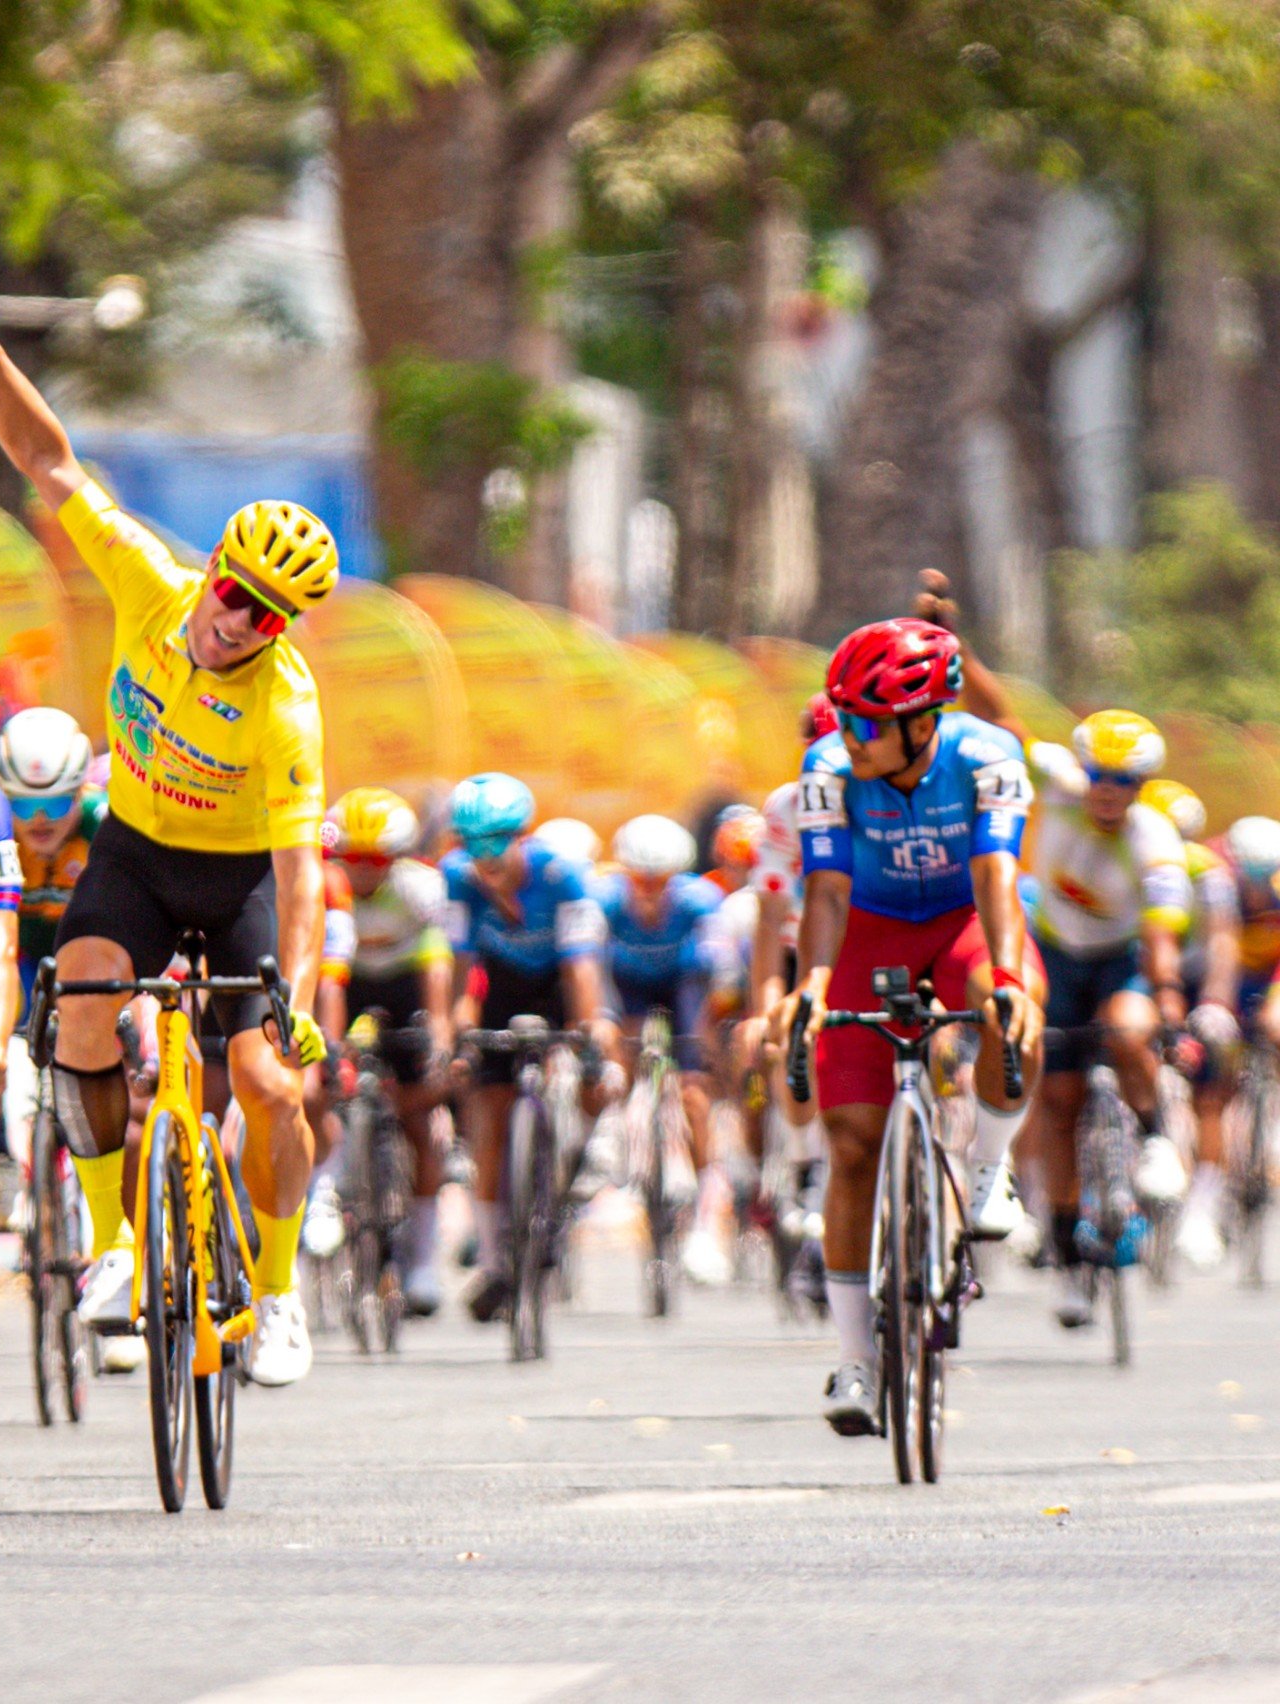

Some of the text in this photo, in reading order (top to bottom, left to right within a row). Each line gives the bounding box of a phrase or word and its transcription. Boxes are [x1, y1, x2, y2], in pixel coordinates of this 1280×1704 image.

[199, 694, 243, 722] HTV
[802, 783, 831, 811] 11
[992, 776, 1022, 798] 11
[866, 827, 883, 841] HO
[885, 828, 906, 842] CHI
[941, 821, 969, 838] CITY
